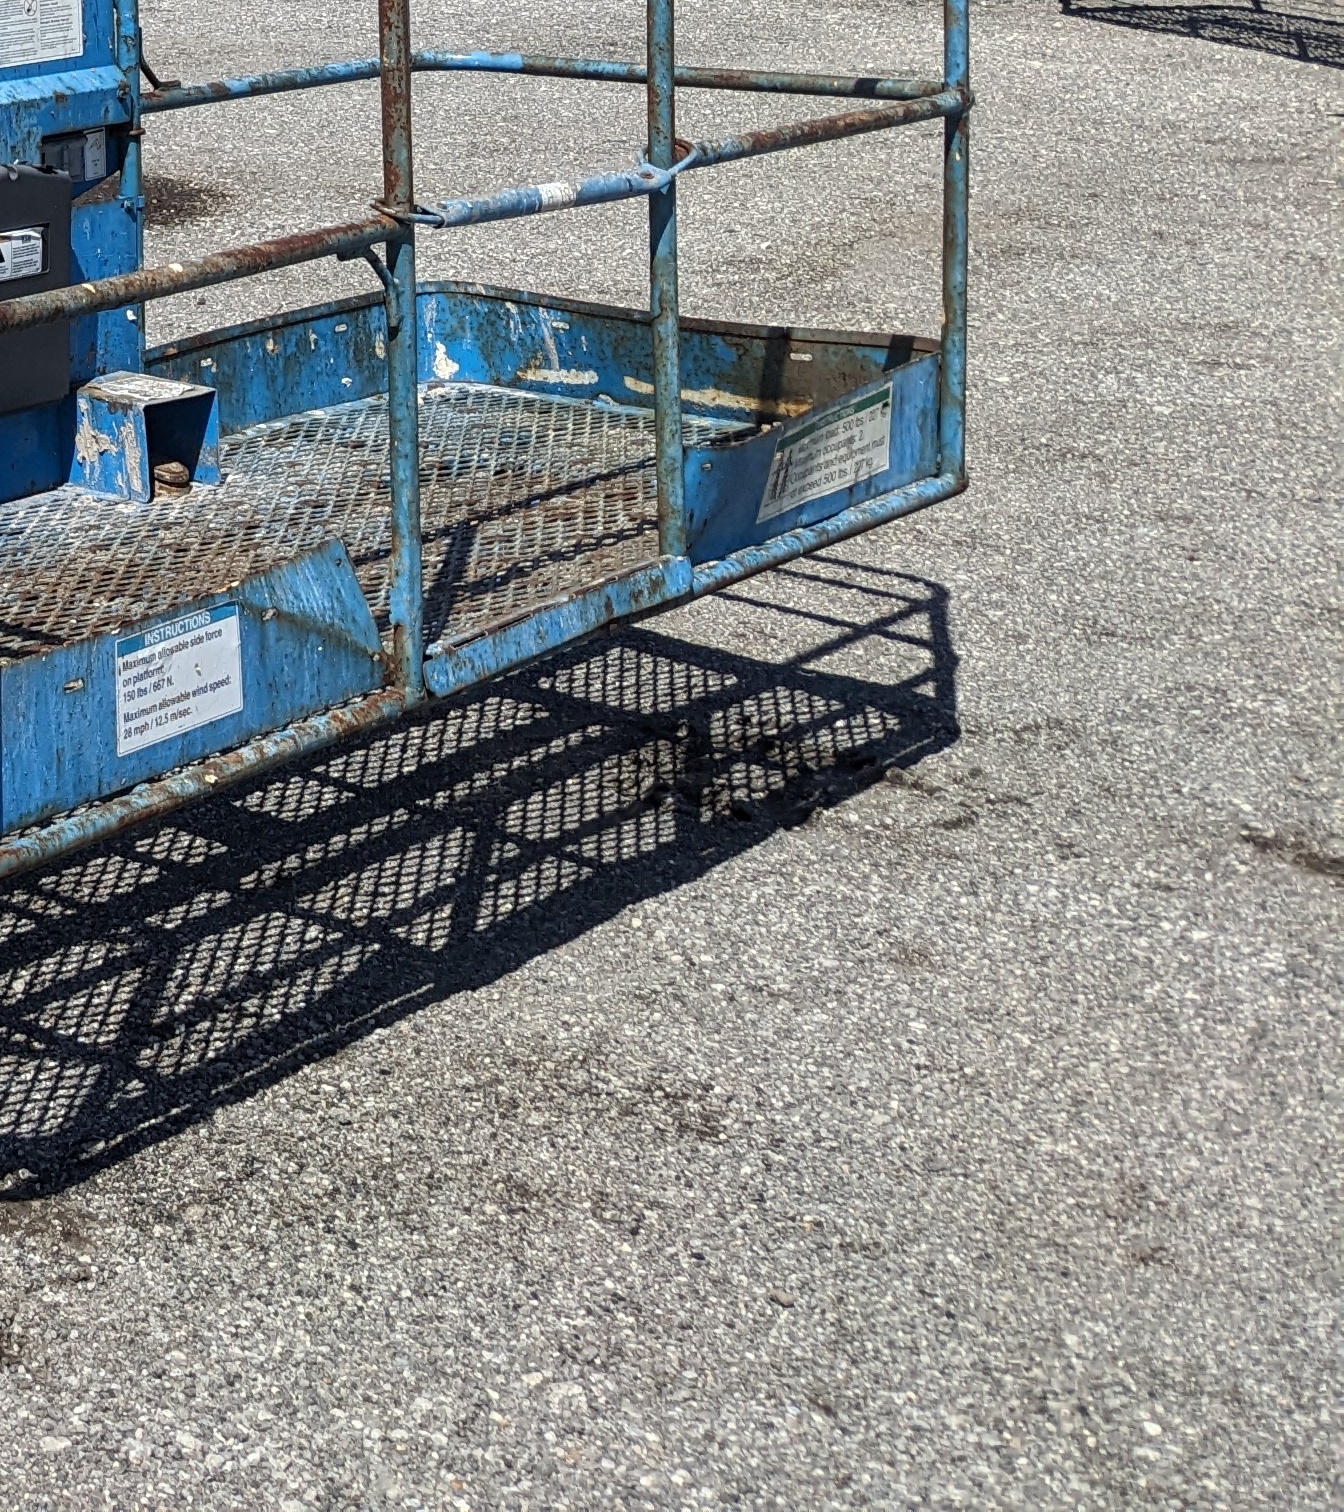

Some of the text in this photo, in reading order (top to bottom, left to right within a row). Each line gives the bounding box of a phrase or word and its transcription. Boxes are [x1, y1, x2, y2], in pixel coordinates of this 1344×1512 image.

[144, 611, 211, 646] INSTRUCTIONS
[122, 627, 223, 672] Maximum allowable side force
[122, 664, 164, 688] on platform:
[123, 689, 135, 703] 150
[137, 685, 148, 698] lbs
[123, 675, 232, 724] Maximum allowable wind speed:
[123, 726, 133, 739] 28
[133, 719, 150, 737] mph
